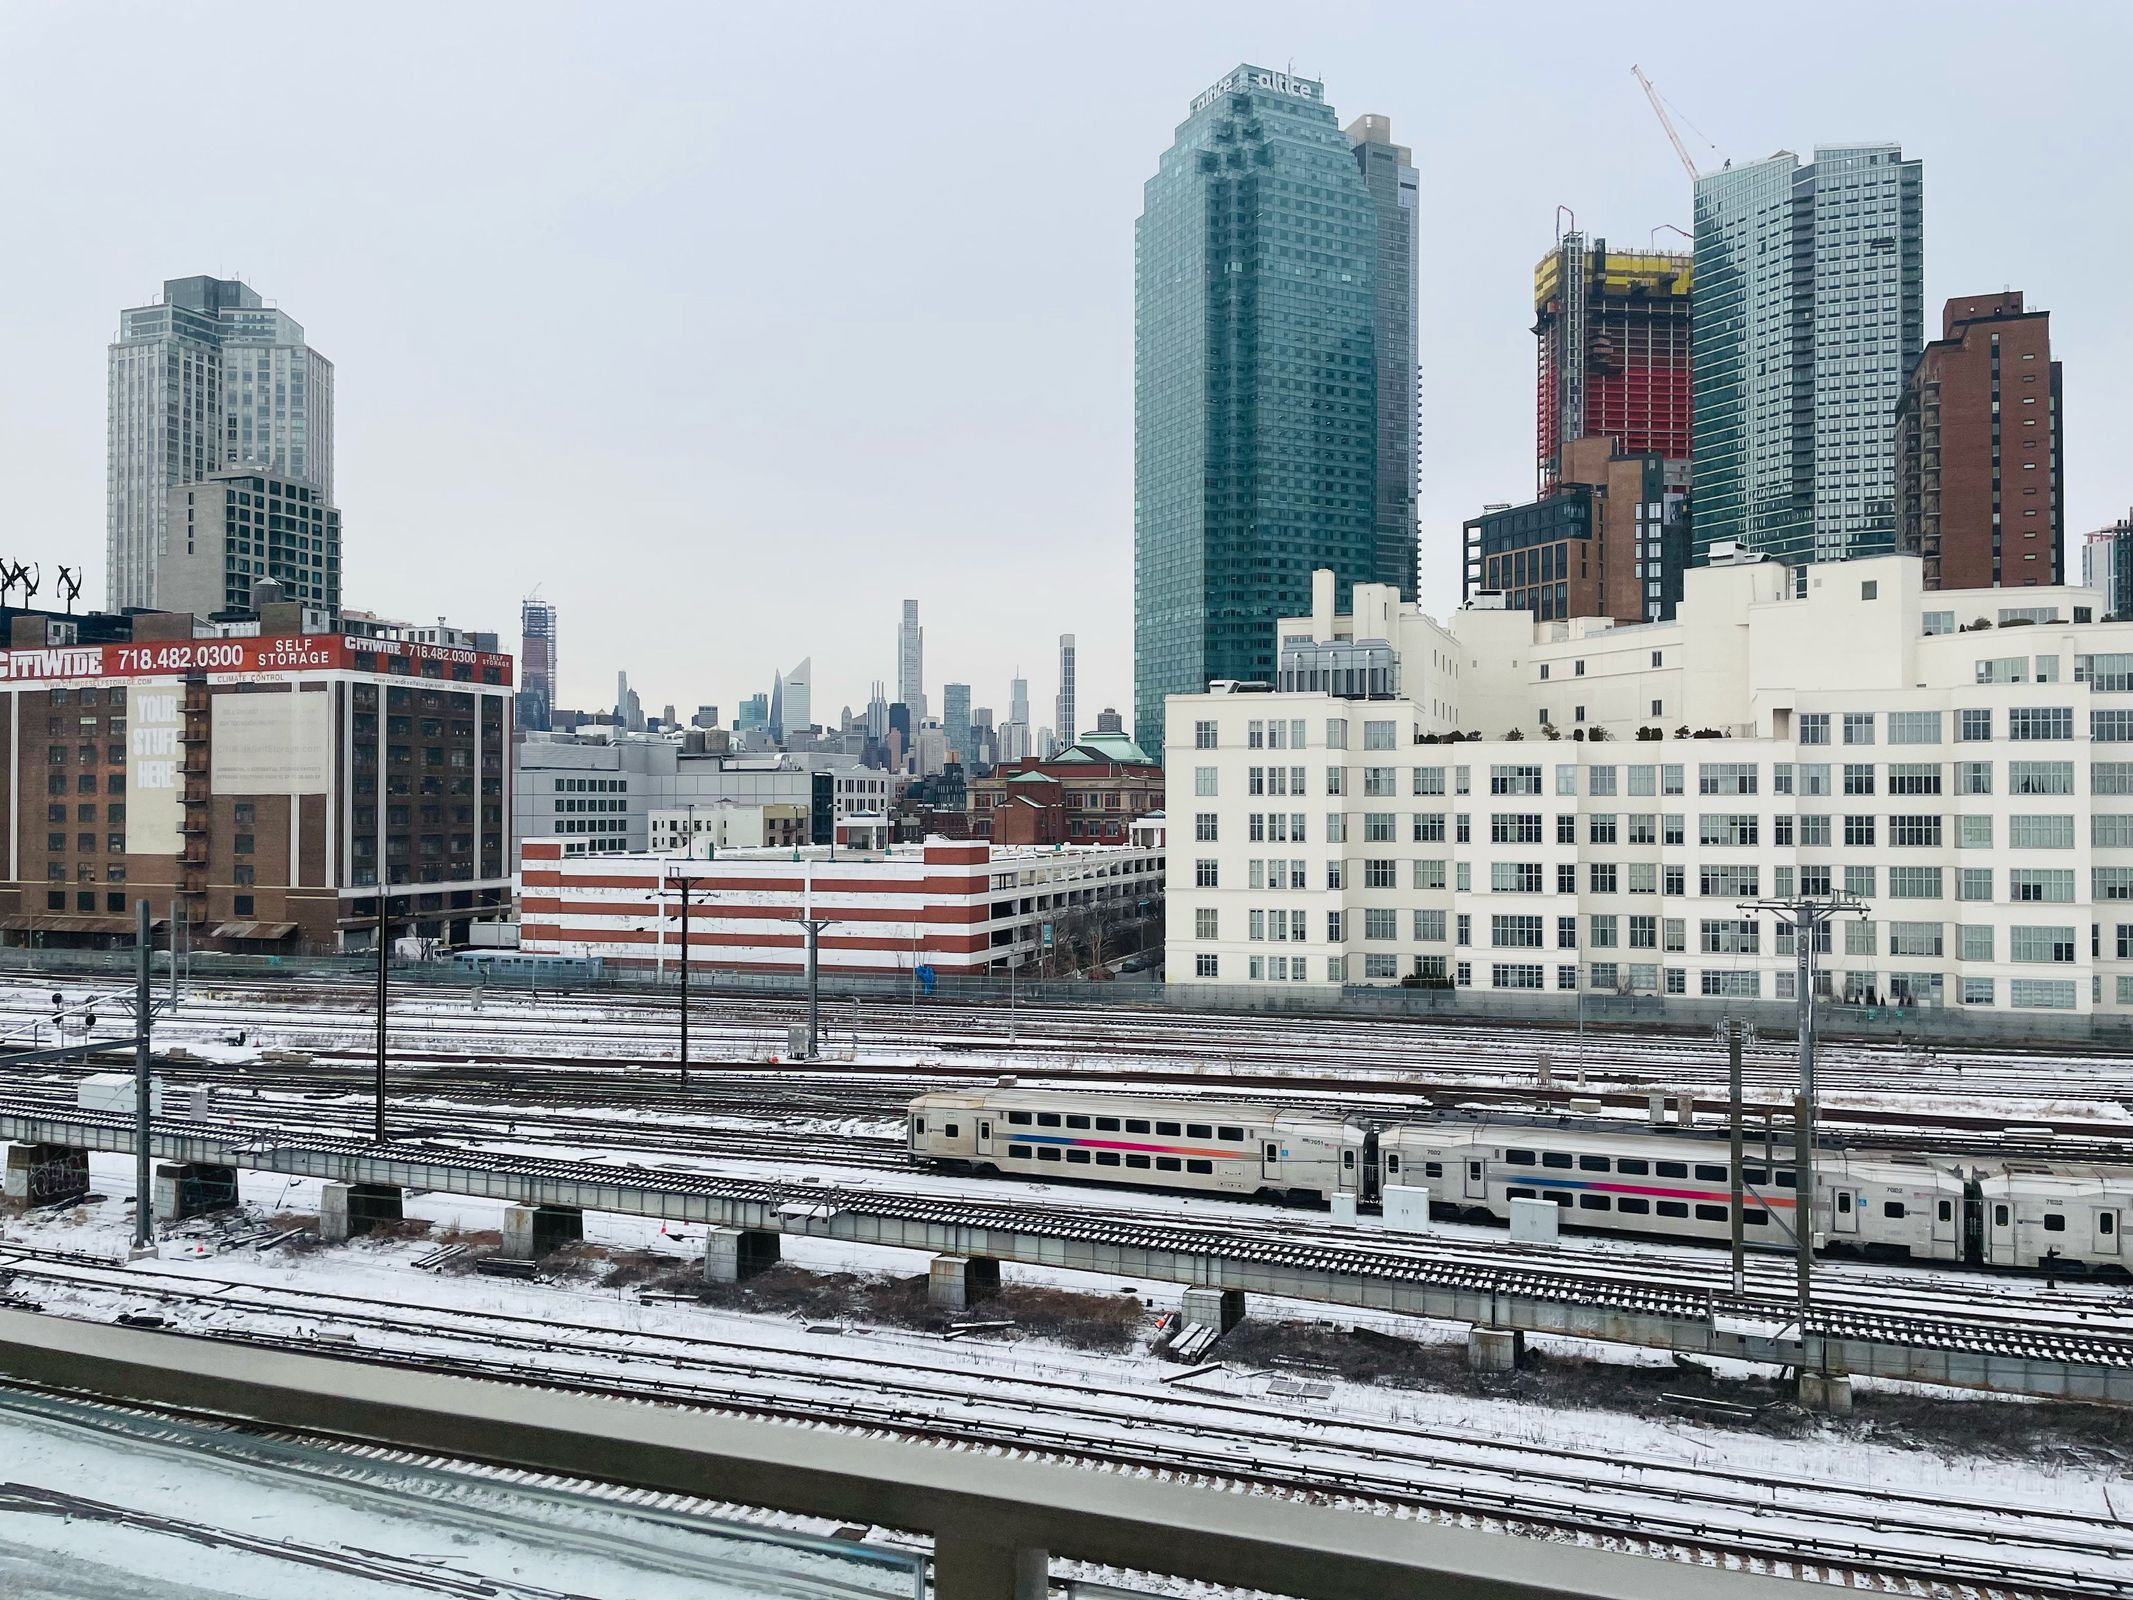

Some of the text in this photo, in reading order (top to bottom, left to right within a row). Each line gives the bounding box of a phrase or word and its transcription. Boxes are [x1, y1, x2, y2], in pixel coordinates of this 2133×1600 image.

[1258, 71, 1312, 99] altice
[275, 639, 312, 652] SELF
[408, 644, 476, 664] 718.482.0300
[118, 644, 244, 670] 718.482.0300
[258, 651, 329, 666] STORAGE
[482, 659, 510, 668] STORAGE
[217, 673, 284, 683] CLIMATE CONTROL
[137, 695, 177, 723] YOUR
[137, 760, 176, 788] HERE
